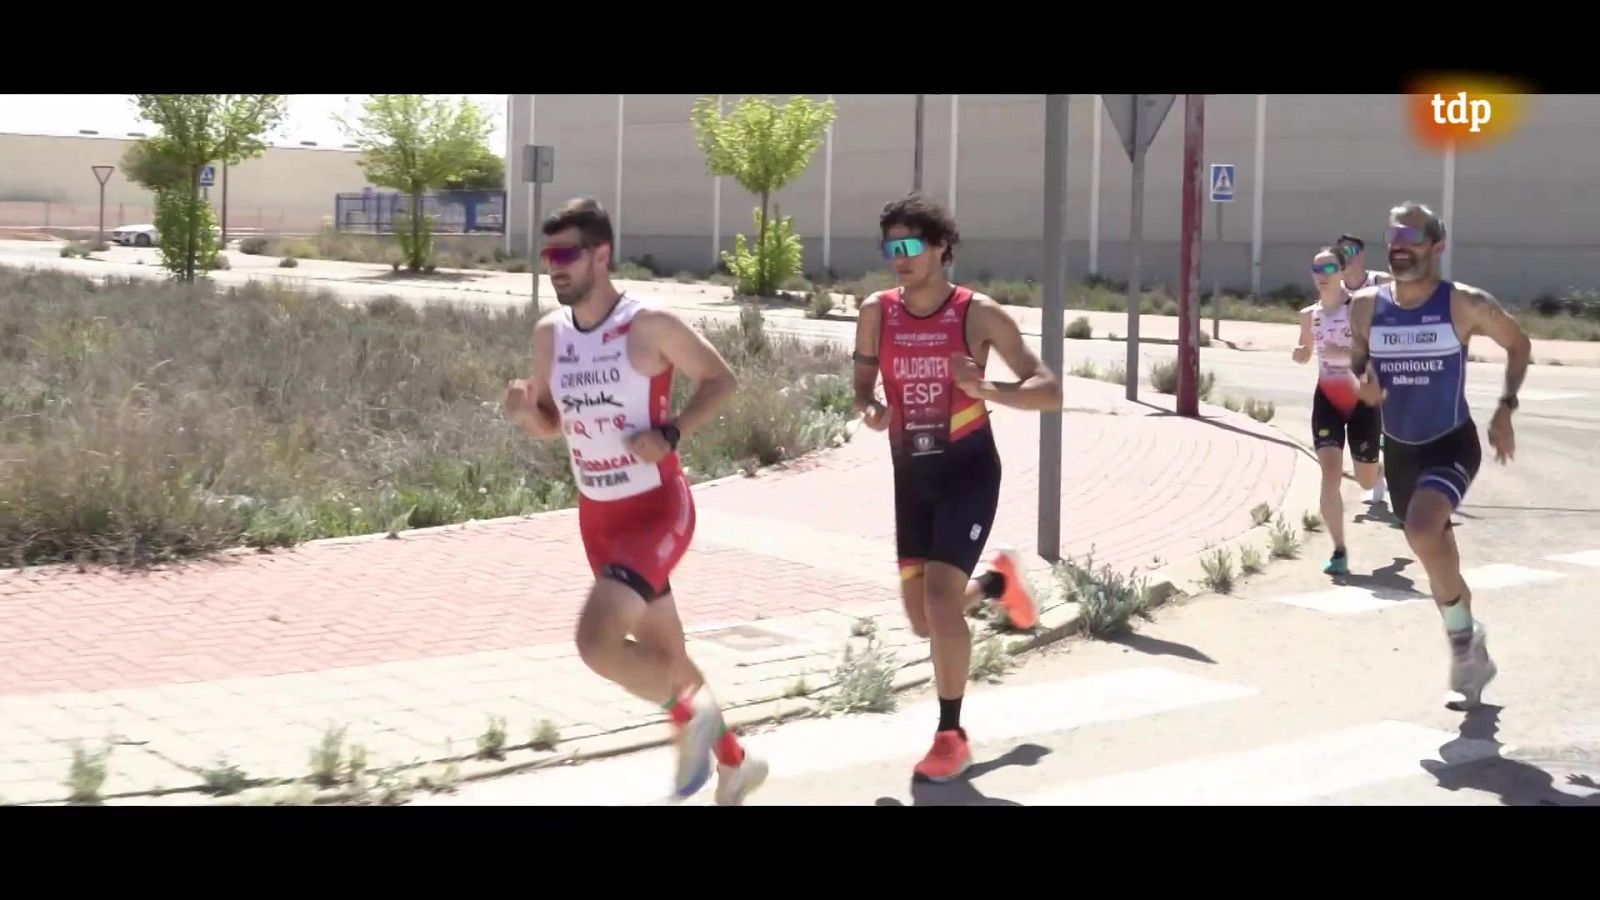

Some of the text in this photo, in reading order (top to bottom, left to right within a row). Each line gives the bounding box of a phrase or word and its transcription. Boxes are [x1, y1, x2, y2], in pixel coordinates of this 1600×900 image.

[560, 367, 620, 389] CERRILLO
[893, 357, 949, 379] CALDENTEY
[903, 382, 942, 404] ESP
